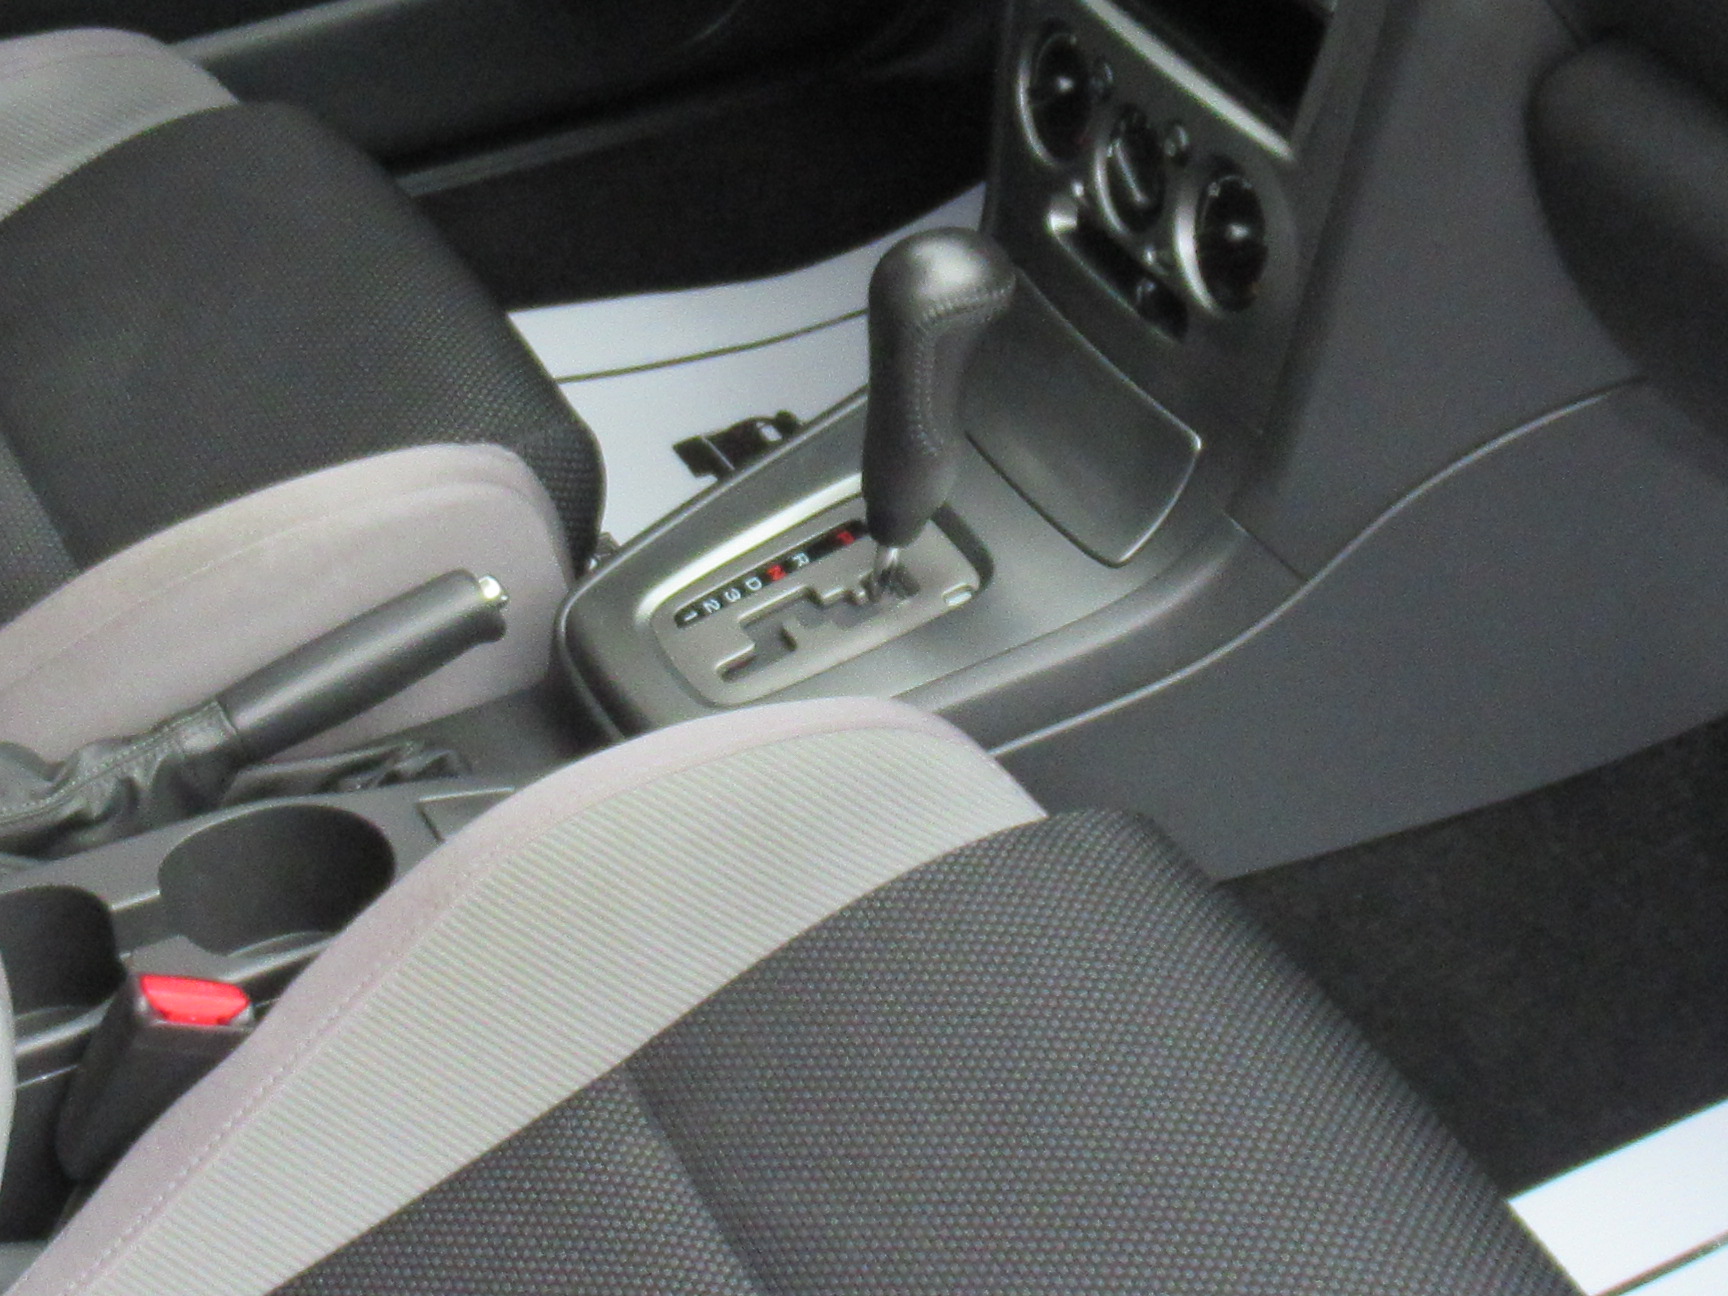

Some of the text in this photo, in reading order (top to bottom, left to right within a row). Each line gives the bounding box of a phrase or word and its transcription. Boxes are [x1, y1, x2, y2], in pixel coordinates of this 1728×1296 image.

[792, 552, 810, 568] R
[745, 576, 762, 591] D
[724, 588, 741, 602] 3
[703, 598, 721, 613] 2
[684, 610, 698, 622] 1
